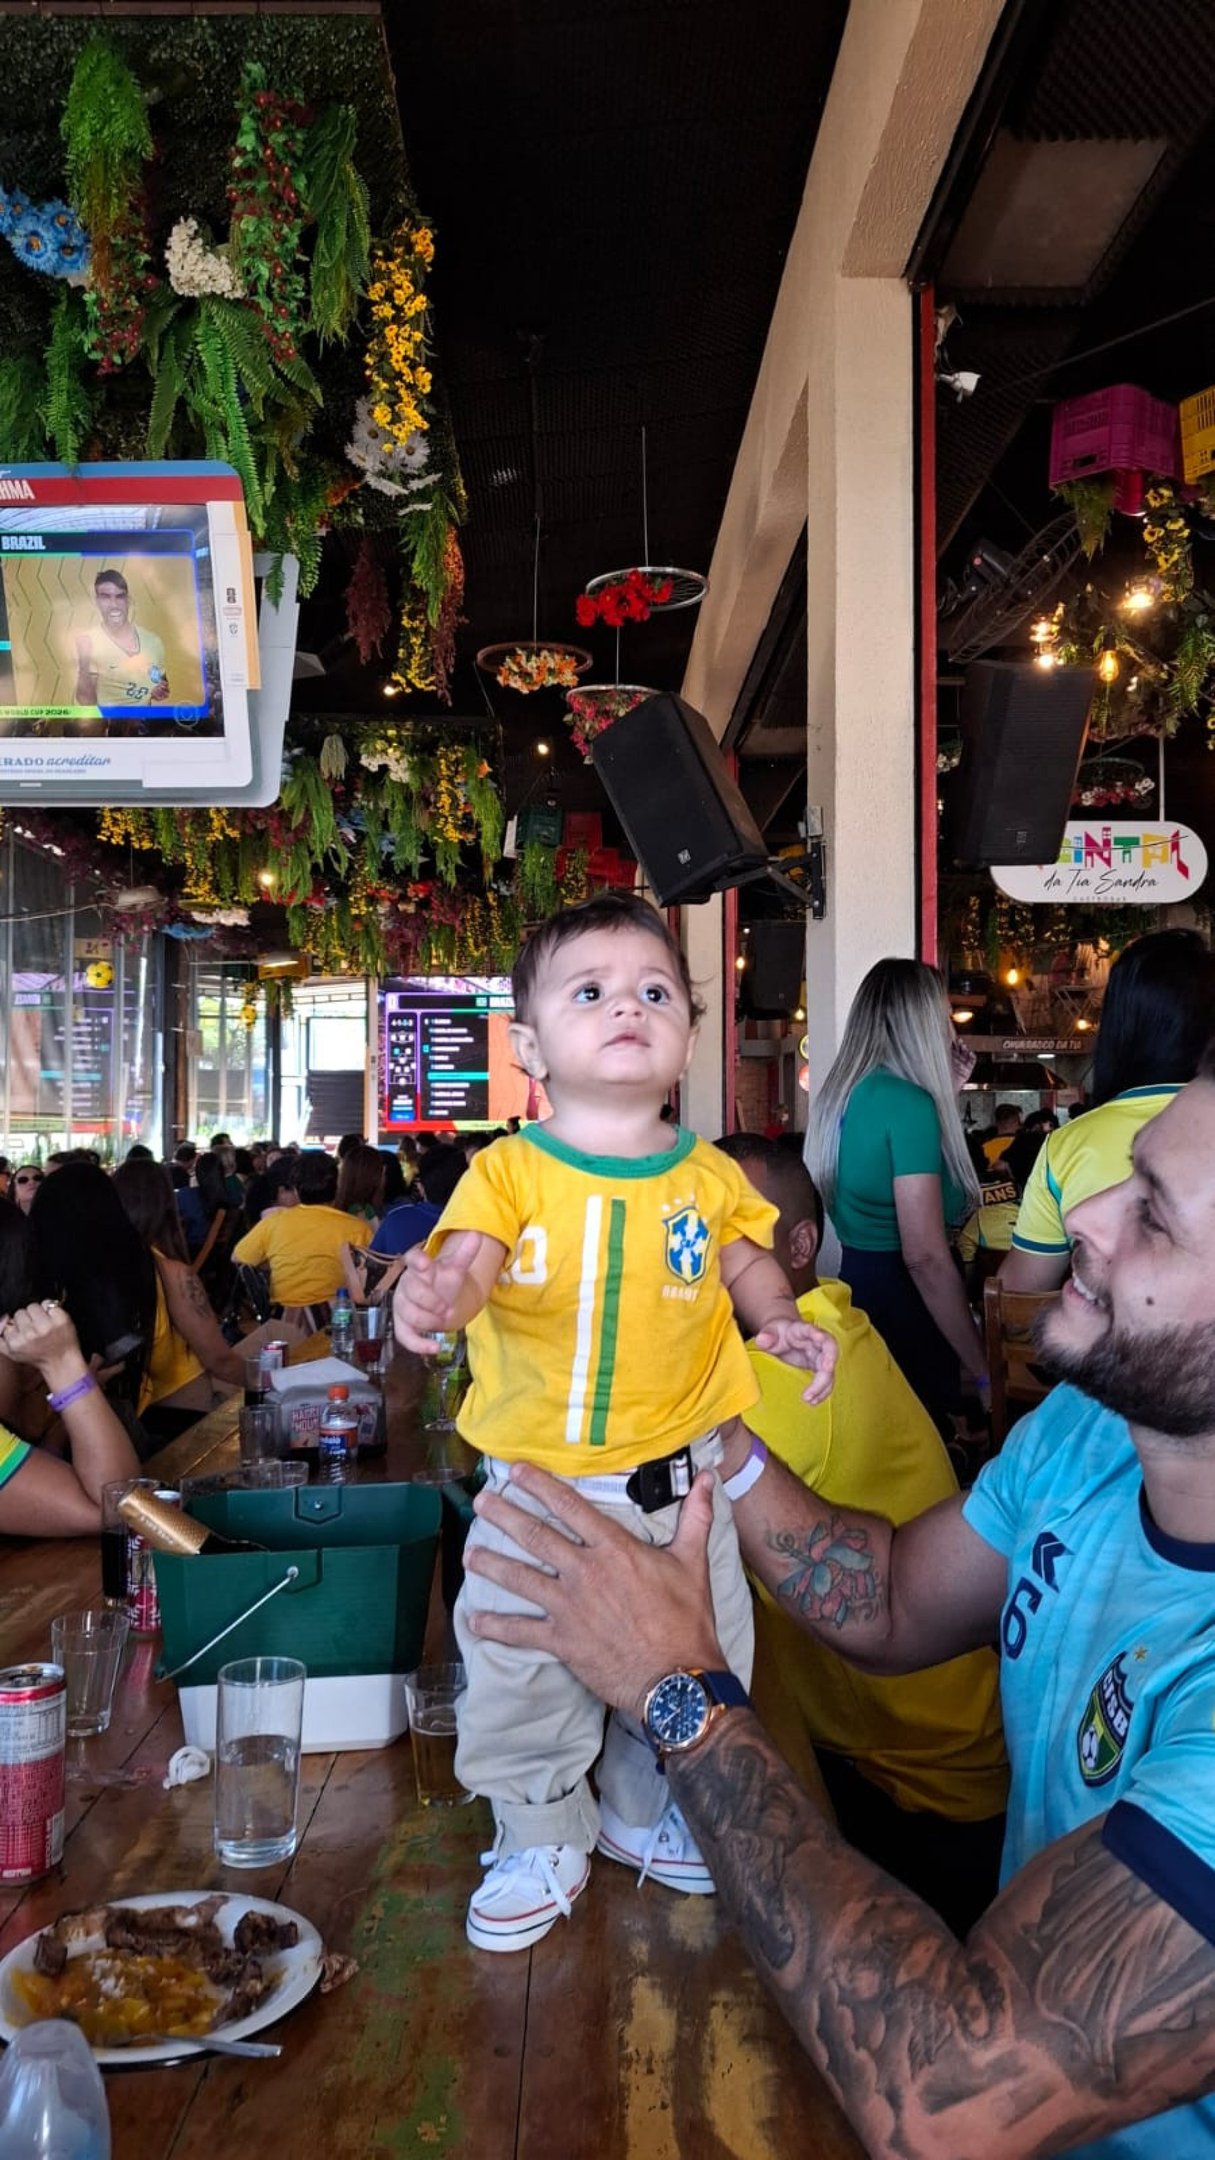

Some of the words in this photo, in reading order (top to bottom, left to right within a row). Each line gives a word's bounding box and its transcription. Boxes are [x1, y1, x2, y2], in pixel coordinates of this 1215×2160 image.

[1, 535, 46, 550] BRAZIL
[46, 754, 111, 766] acreditar
[1043, 870, 1062, 891] da
[1066, 869, 1090, 894] Tia
[1094, 869, 1160, 895] Sandra
[984, 1185, 1016, 1204] ANS
[499, 1227, 547, 1284] 0
